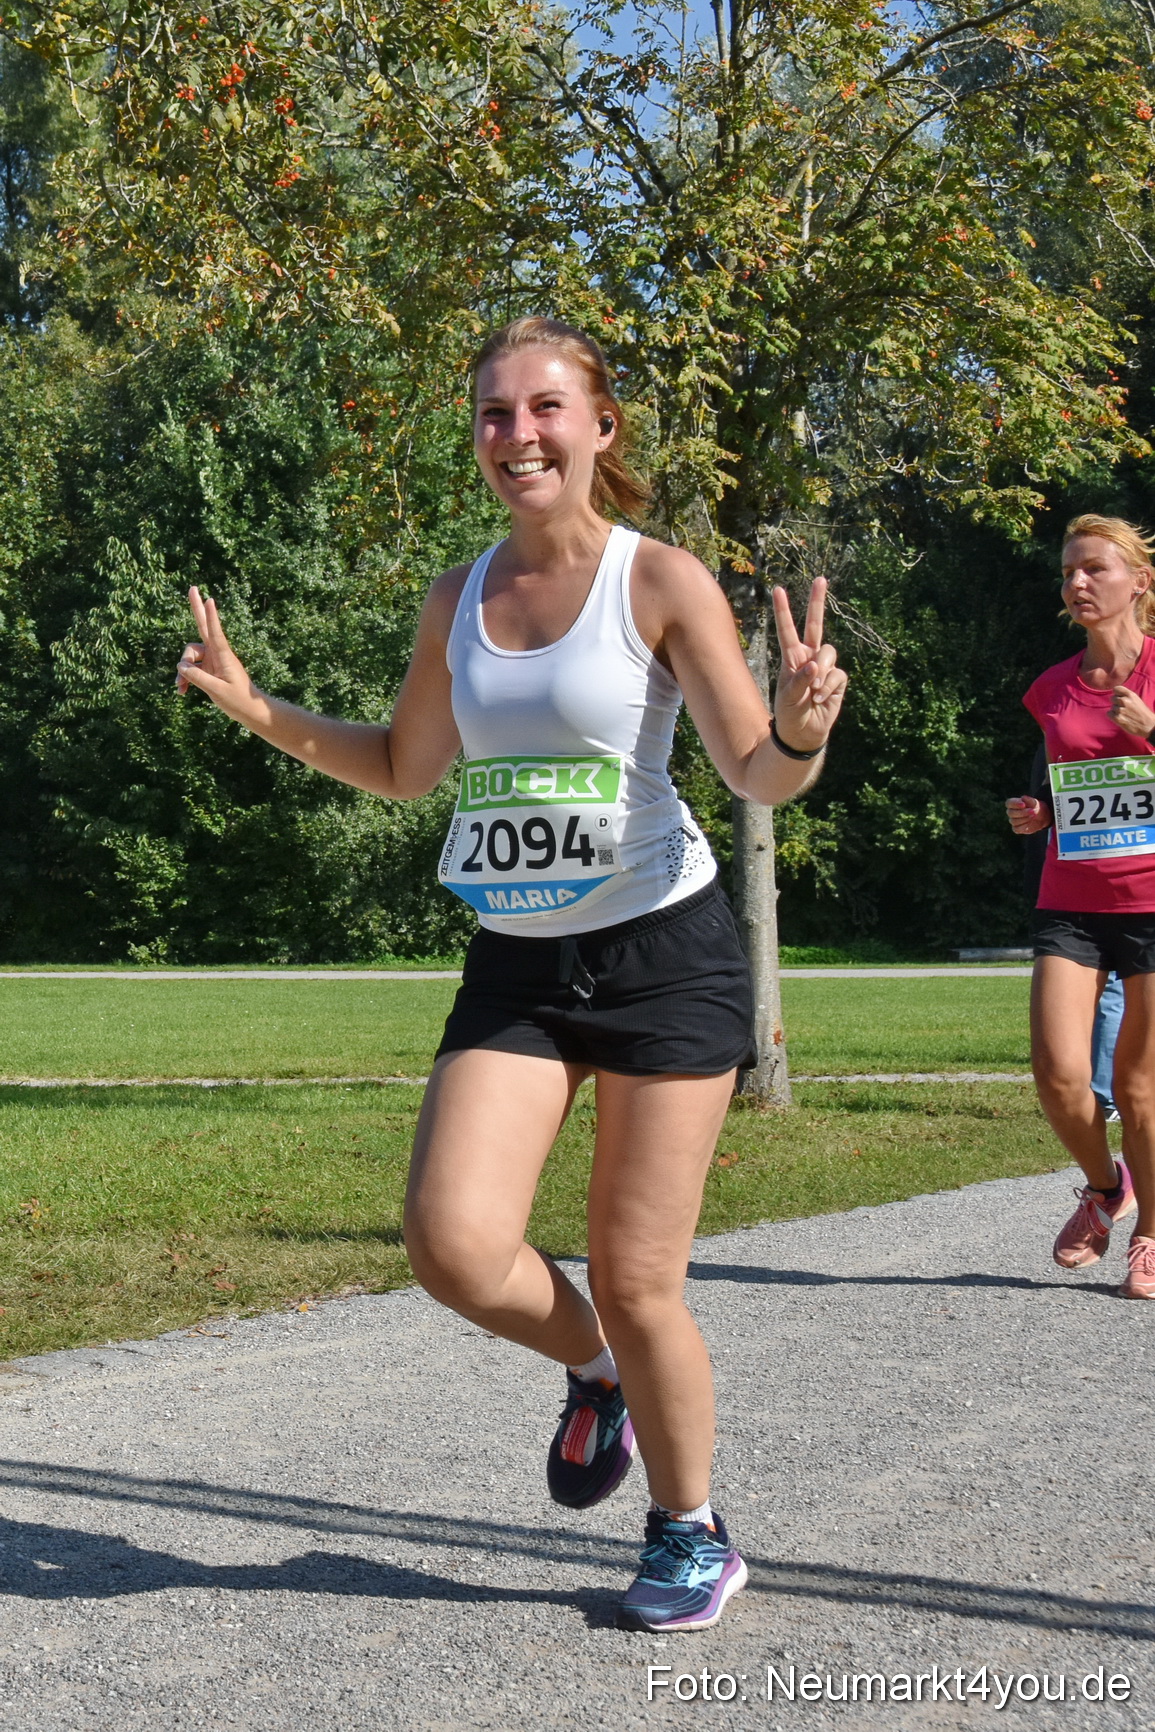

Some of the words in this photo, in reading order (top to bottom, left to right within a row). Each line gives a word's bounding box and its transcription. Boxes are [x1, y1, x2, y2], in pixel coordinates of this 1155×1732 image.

[467, 764, 601, 804] BOCK
[1062, 760, 1153, 787] BOCK
[1068, 790, 1154, 826] 2243
[461, 815, 595, 872] 2094
[1080, 830, 1147, 848] RENATE
[485, 888, 578, 910] MARIA
